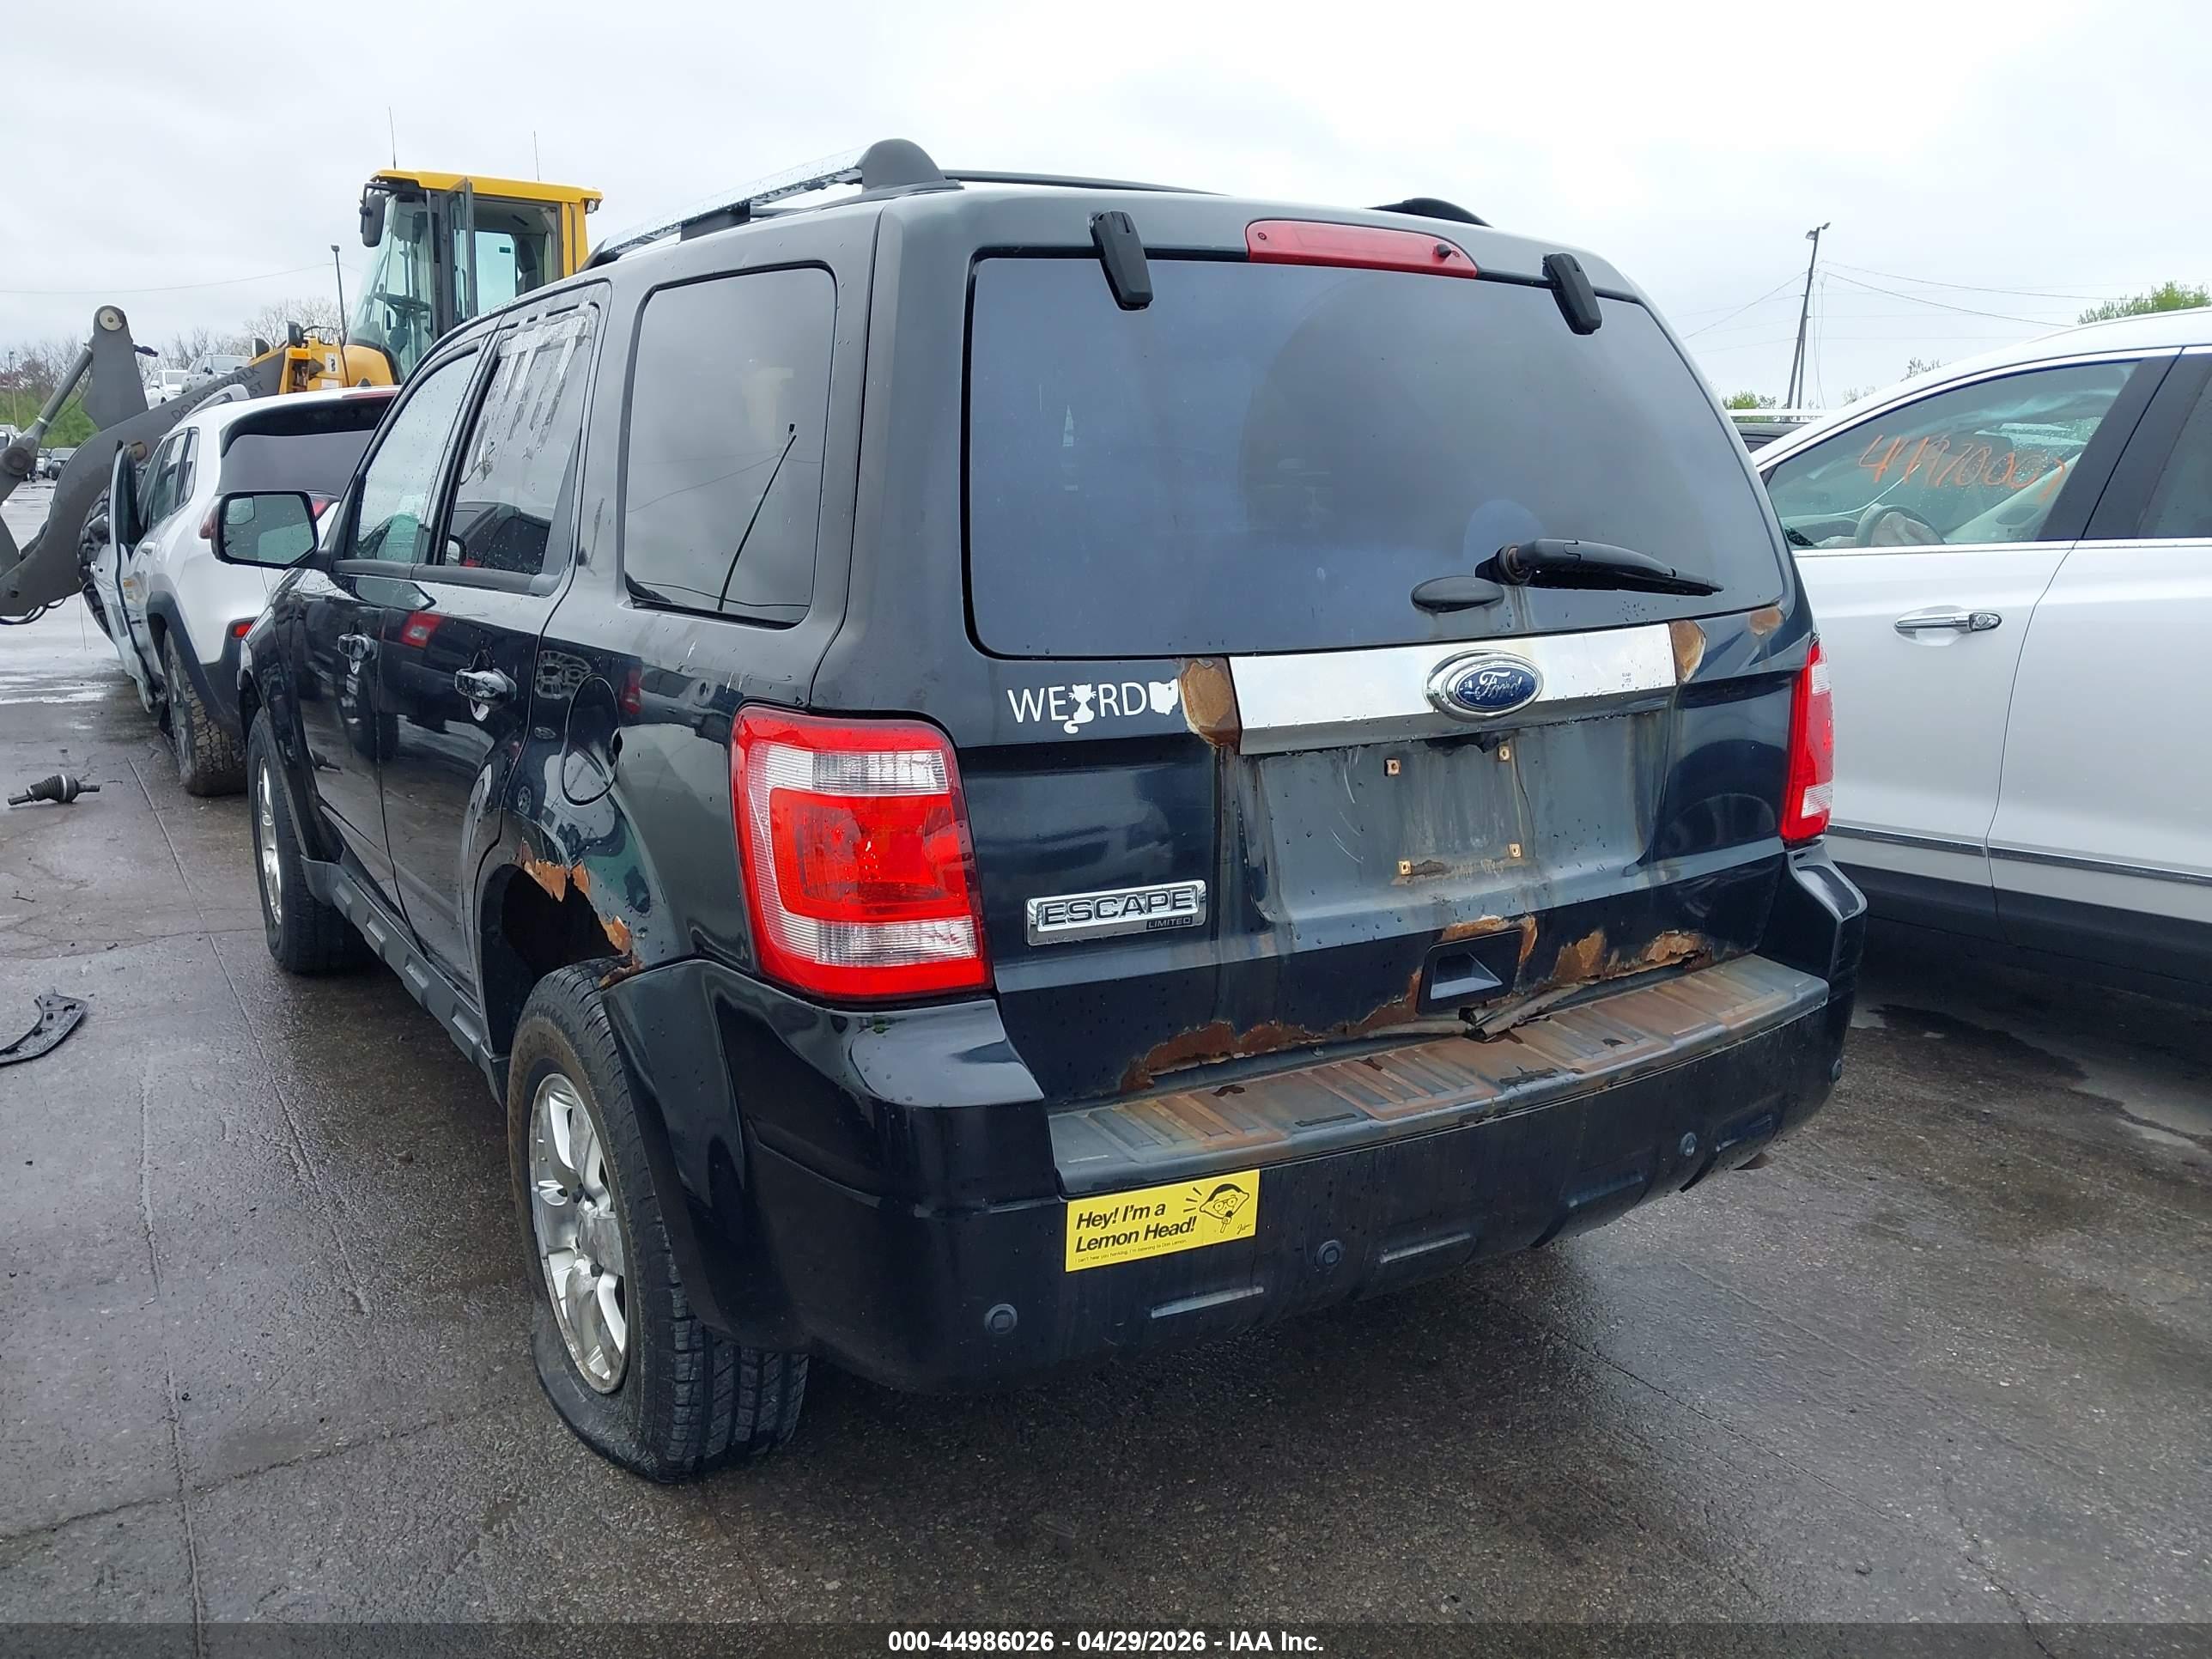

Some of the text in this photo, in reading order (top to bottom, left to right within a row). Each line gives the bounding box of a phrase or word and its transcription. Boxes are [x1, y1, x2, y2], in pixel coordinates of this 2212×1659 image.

[171, 404, 190, 420] DO
[1043, 889, 1194, 927] ESCAPE
[1147, 916, 1192, 929] LIMITED
[1076, 1203, 1166, 1230] Hey! I'm a
[1075, 1216, 1198, 1253] Lemon Head!
